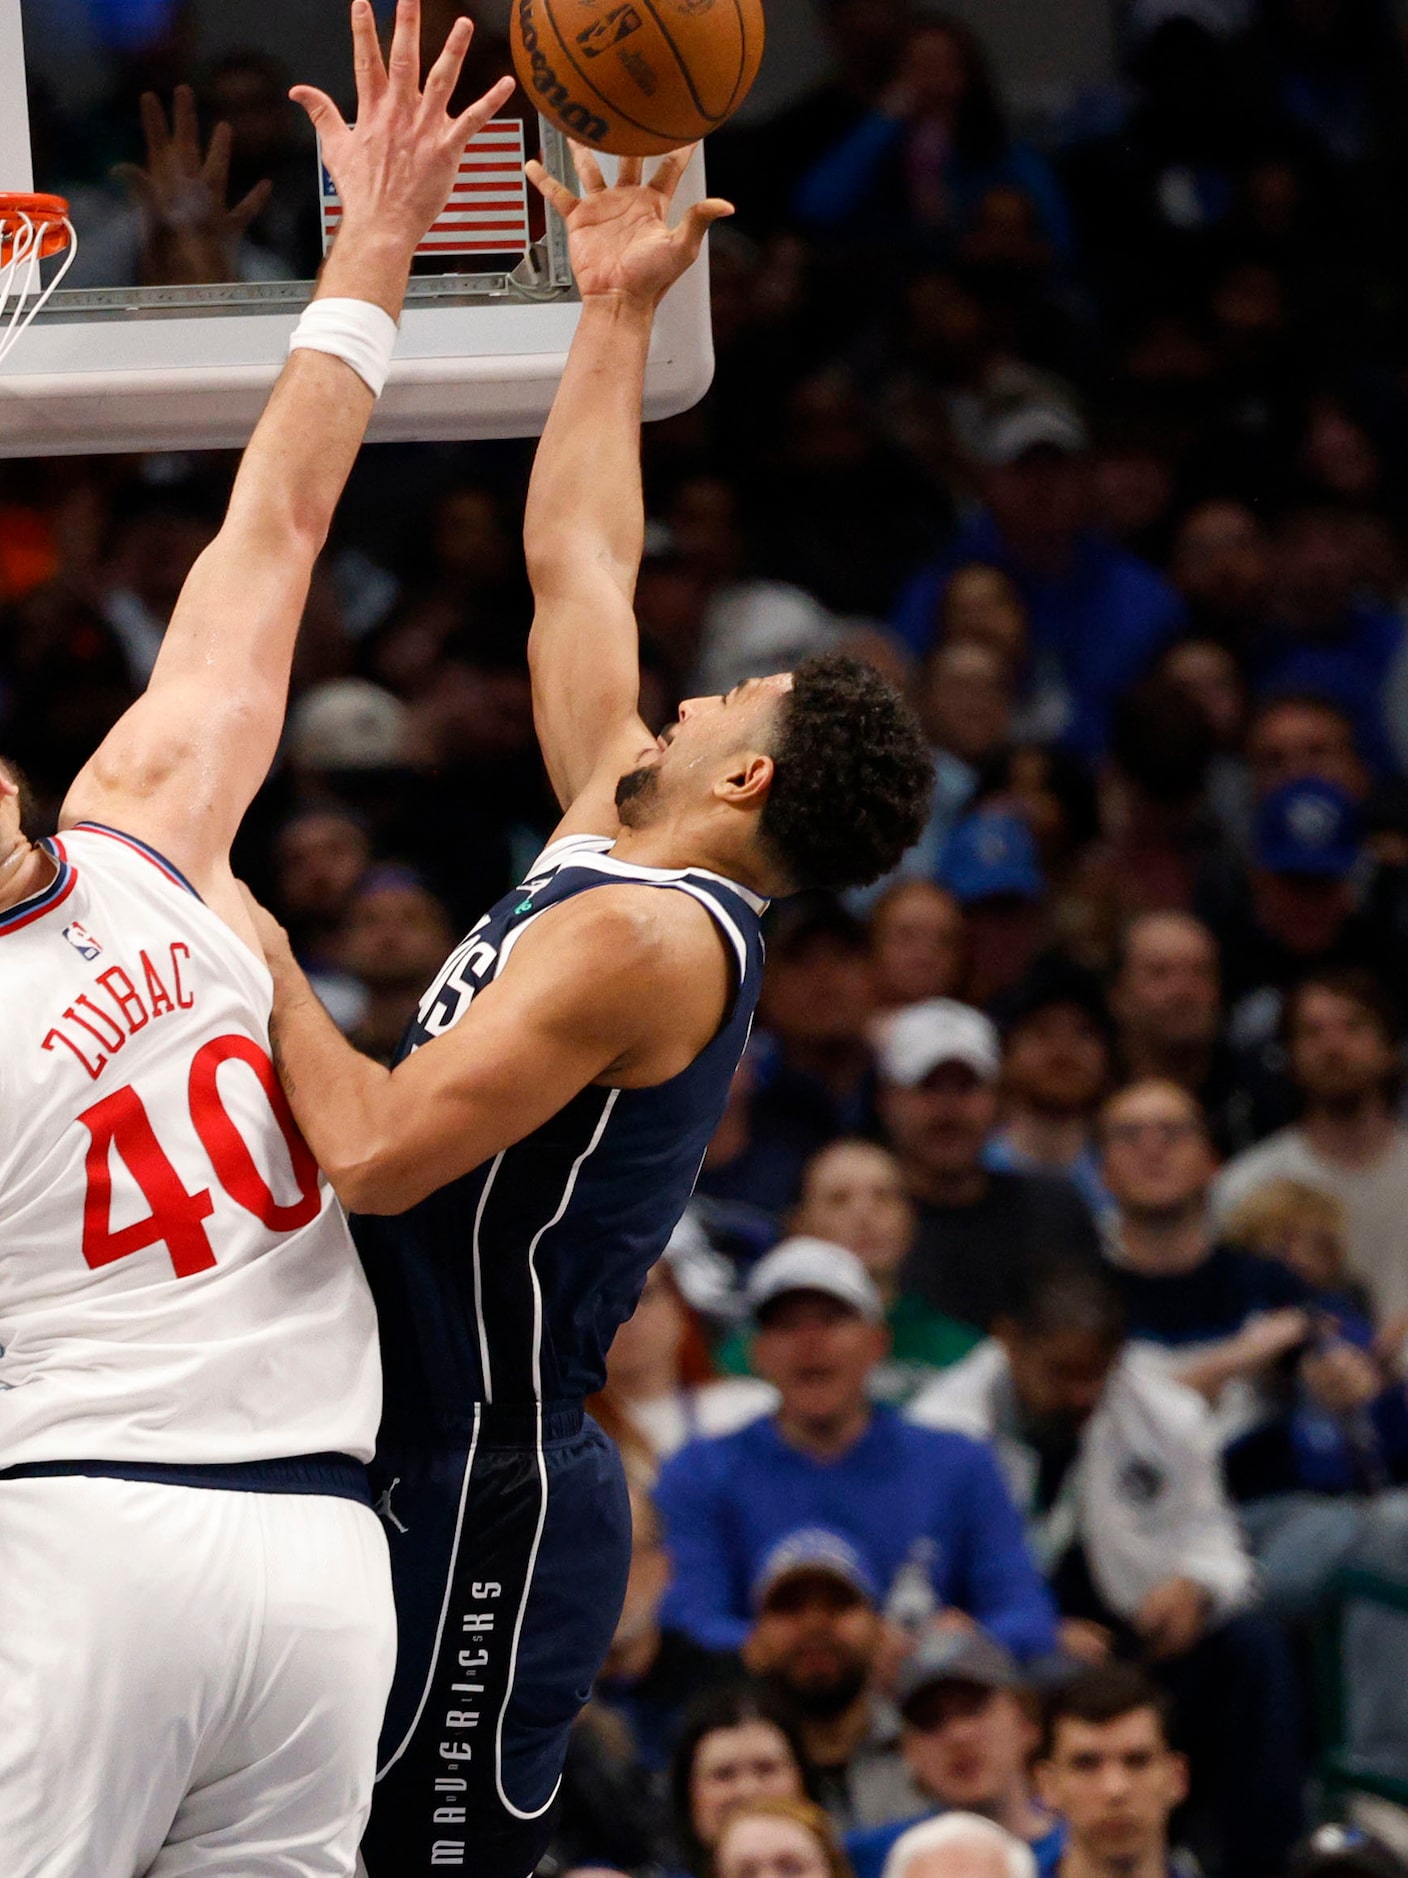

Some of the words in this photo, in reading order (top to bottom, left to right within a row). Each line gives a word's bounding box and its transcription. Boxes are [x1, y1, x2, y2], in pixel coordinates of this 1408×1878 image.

[41, 942, 194, 1081] ZUBAC
[74, 1033, 321, 1279] 40
[431, 1581, 502, 1865] MAVERICKS
